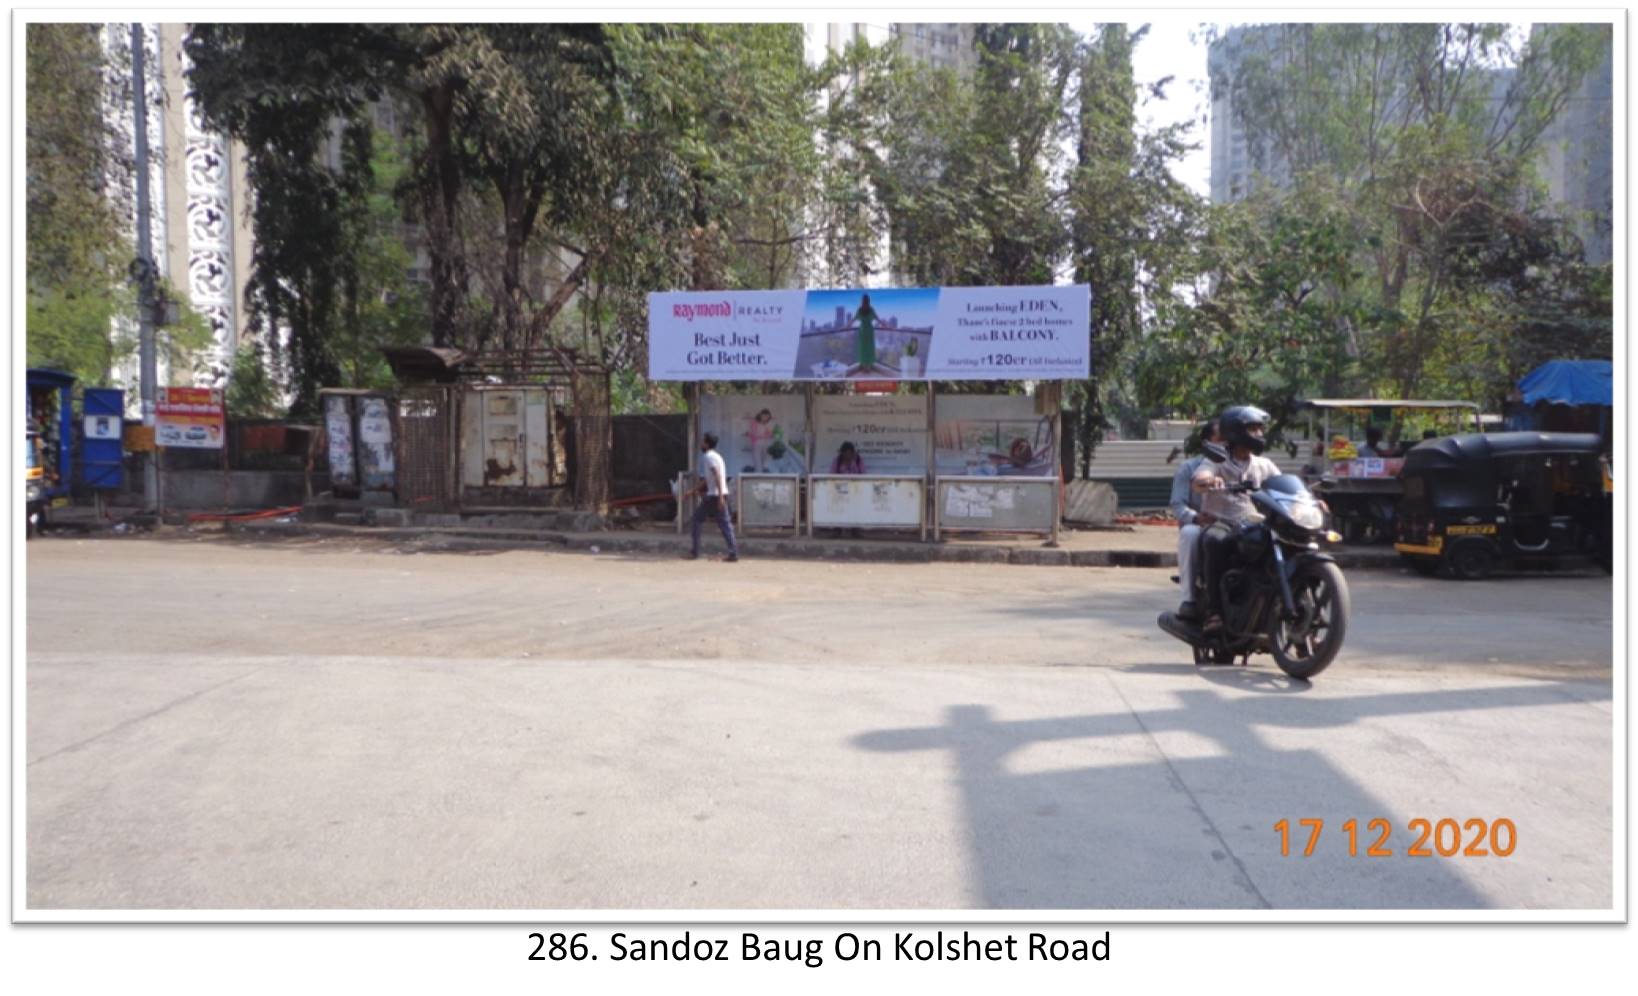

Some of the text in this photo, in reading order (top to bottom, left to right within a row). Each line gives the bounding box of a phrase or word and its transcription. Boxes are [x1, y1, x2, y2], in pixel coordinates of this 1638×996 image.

[673, 301, 783, 321] Raymond REALTY
[966, 299, 1064, 314] Launching EDEN,
[1044, 317, 1073, 326] homes
[694, 332, 761, 347] Best Just
[969, 328, 1060, 342] with BALCONY.
[686, 350, 768, 366] Got Better.
